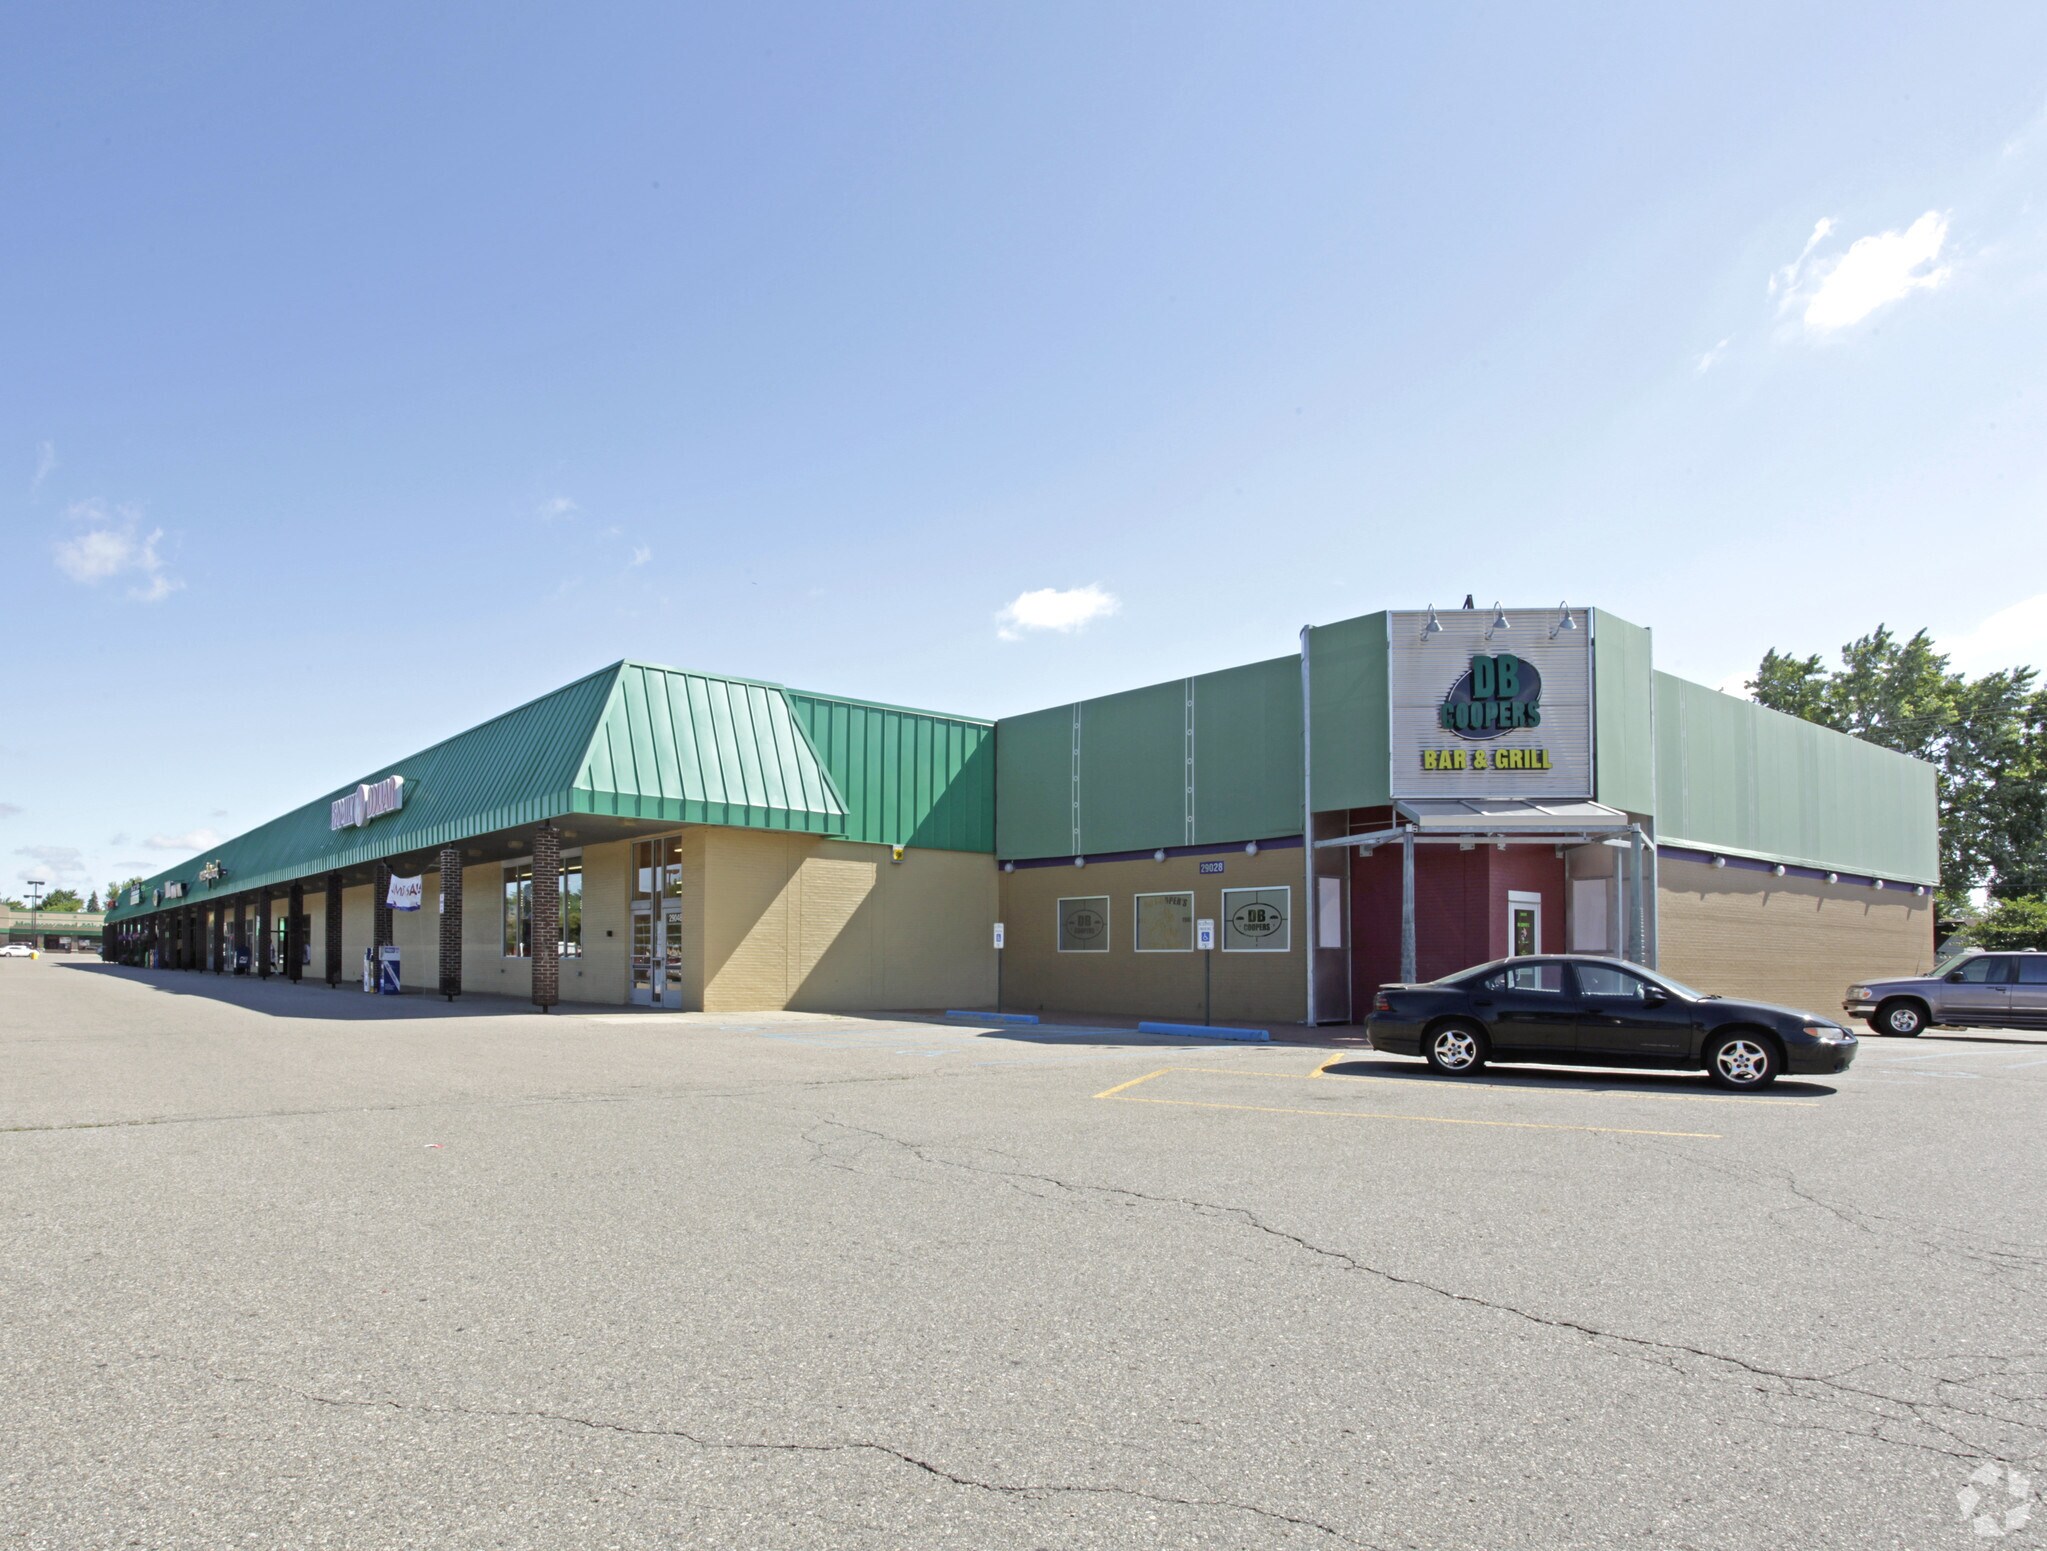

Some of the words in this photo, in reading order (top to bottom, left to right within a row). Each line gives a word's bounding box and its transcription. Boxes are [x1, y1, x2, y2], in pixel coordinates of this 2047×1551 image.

[1473, 654, 1519, 698] DB
[1441, 701, 1541, 730] COOPERS
[1424, 749, 1467, 769] BAR
[1474, 749, 1488, 769] &
[1495, 748, 1552, 769] GRILL
[1201, 863, 1223, 873] 29028
[1077, 915, 1091, 927] DB
[1248, 909, 1266, 922] DB
[1243, 923, 1271, 931] COOPERS
